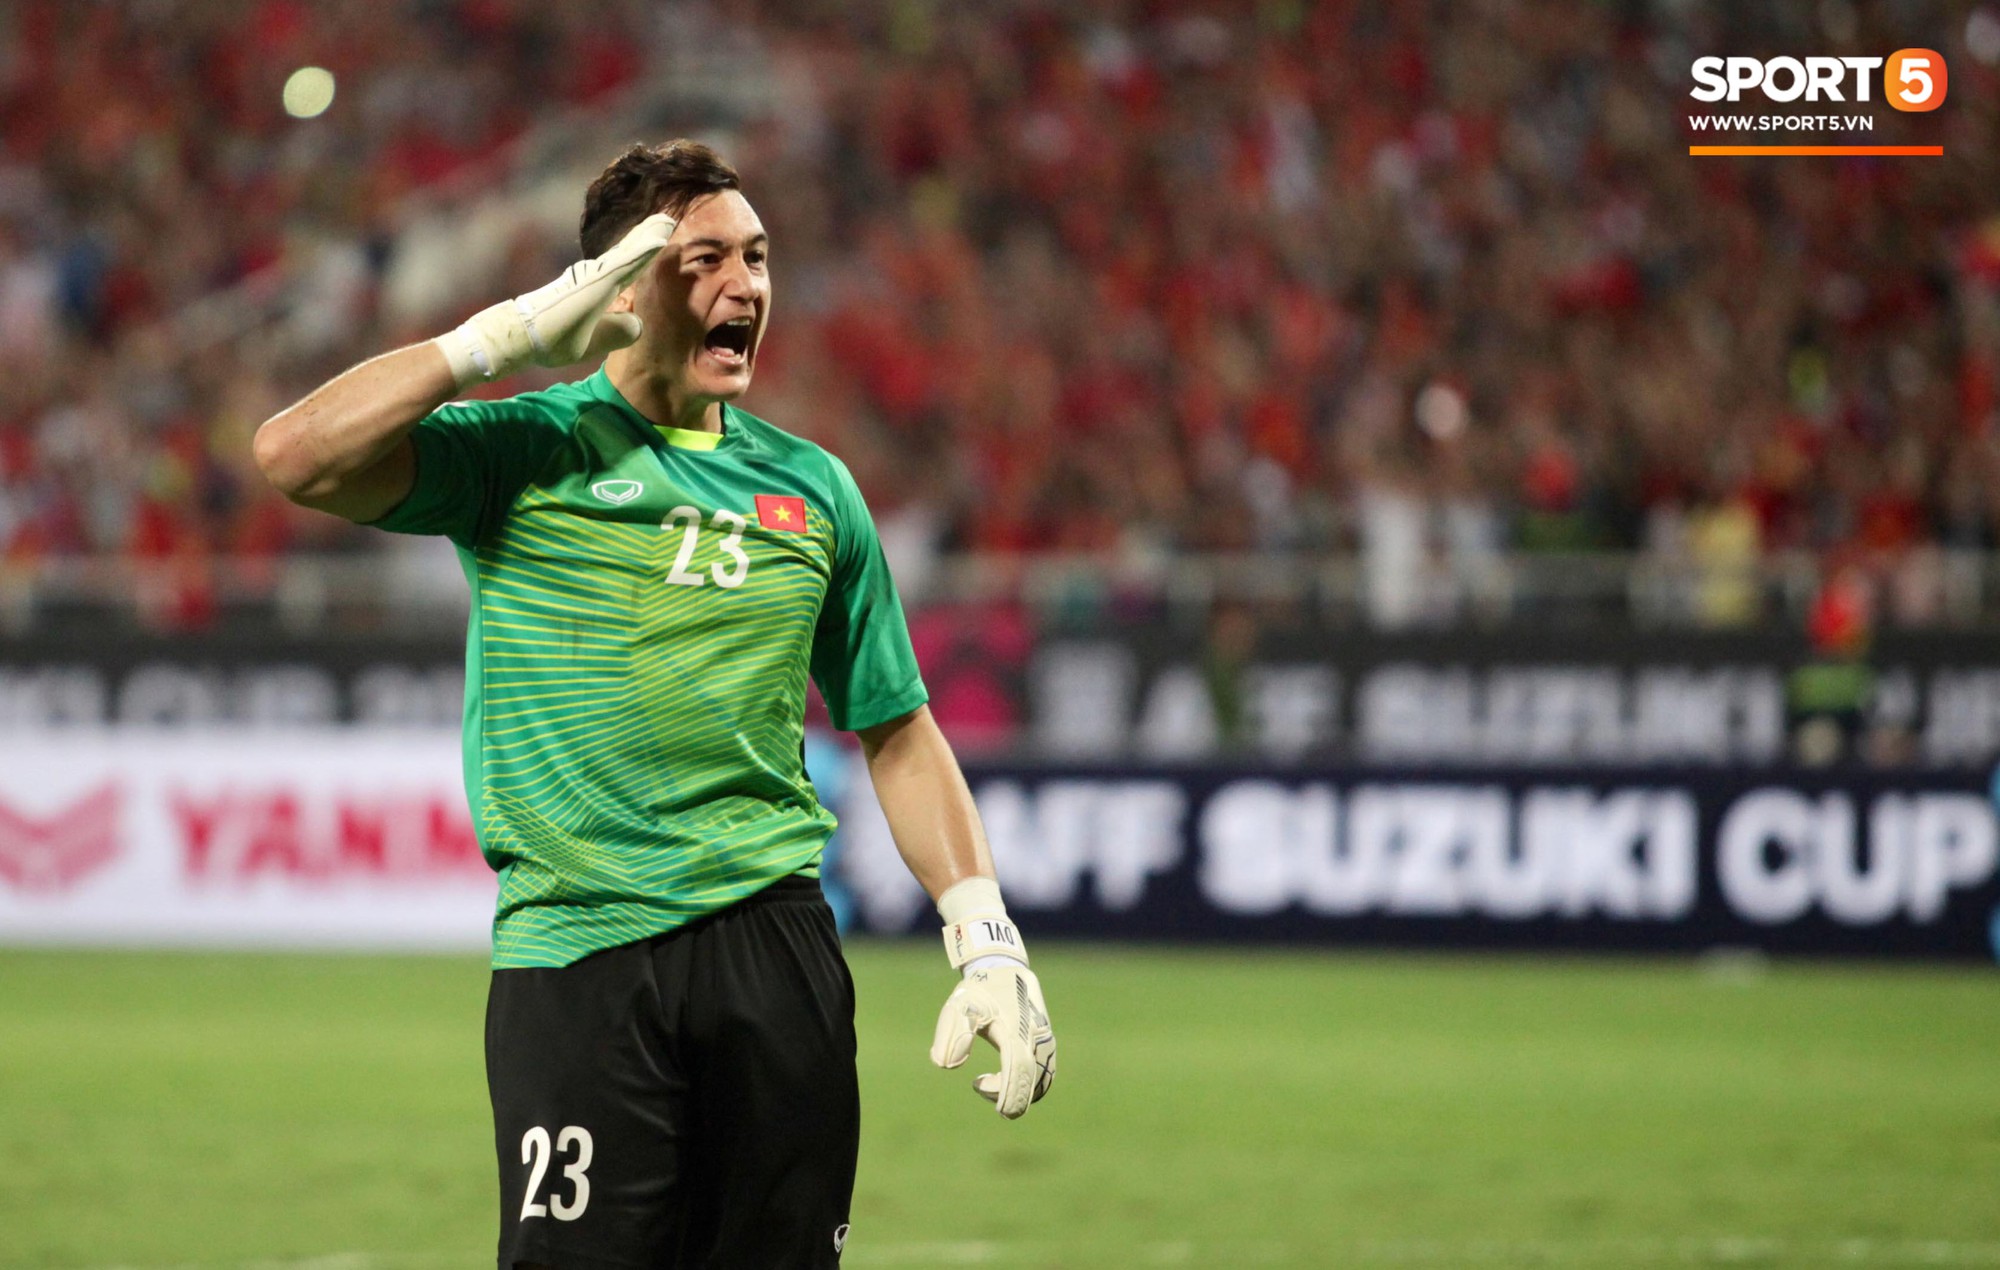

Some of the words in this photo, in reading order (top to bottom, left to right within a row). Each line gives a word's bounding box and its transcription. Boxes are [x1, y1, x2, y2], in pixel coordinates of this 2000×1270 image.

[660, 505, 750, 588] 23
[1199, 779, 1697, 917] SUZUKI
[1715, 787, 1997, 924] CUP
[982, 921, 1015, 947] DVL
[520, 1126, 593, 1222] 23
